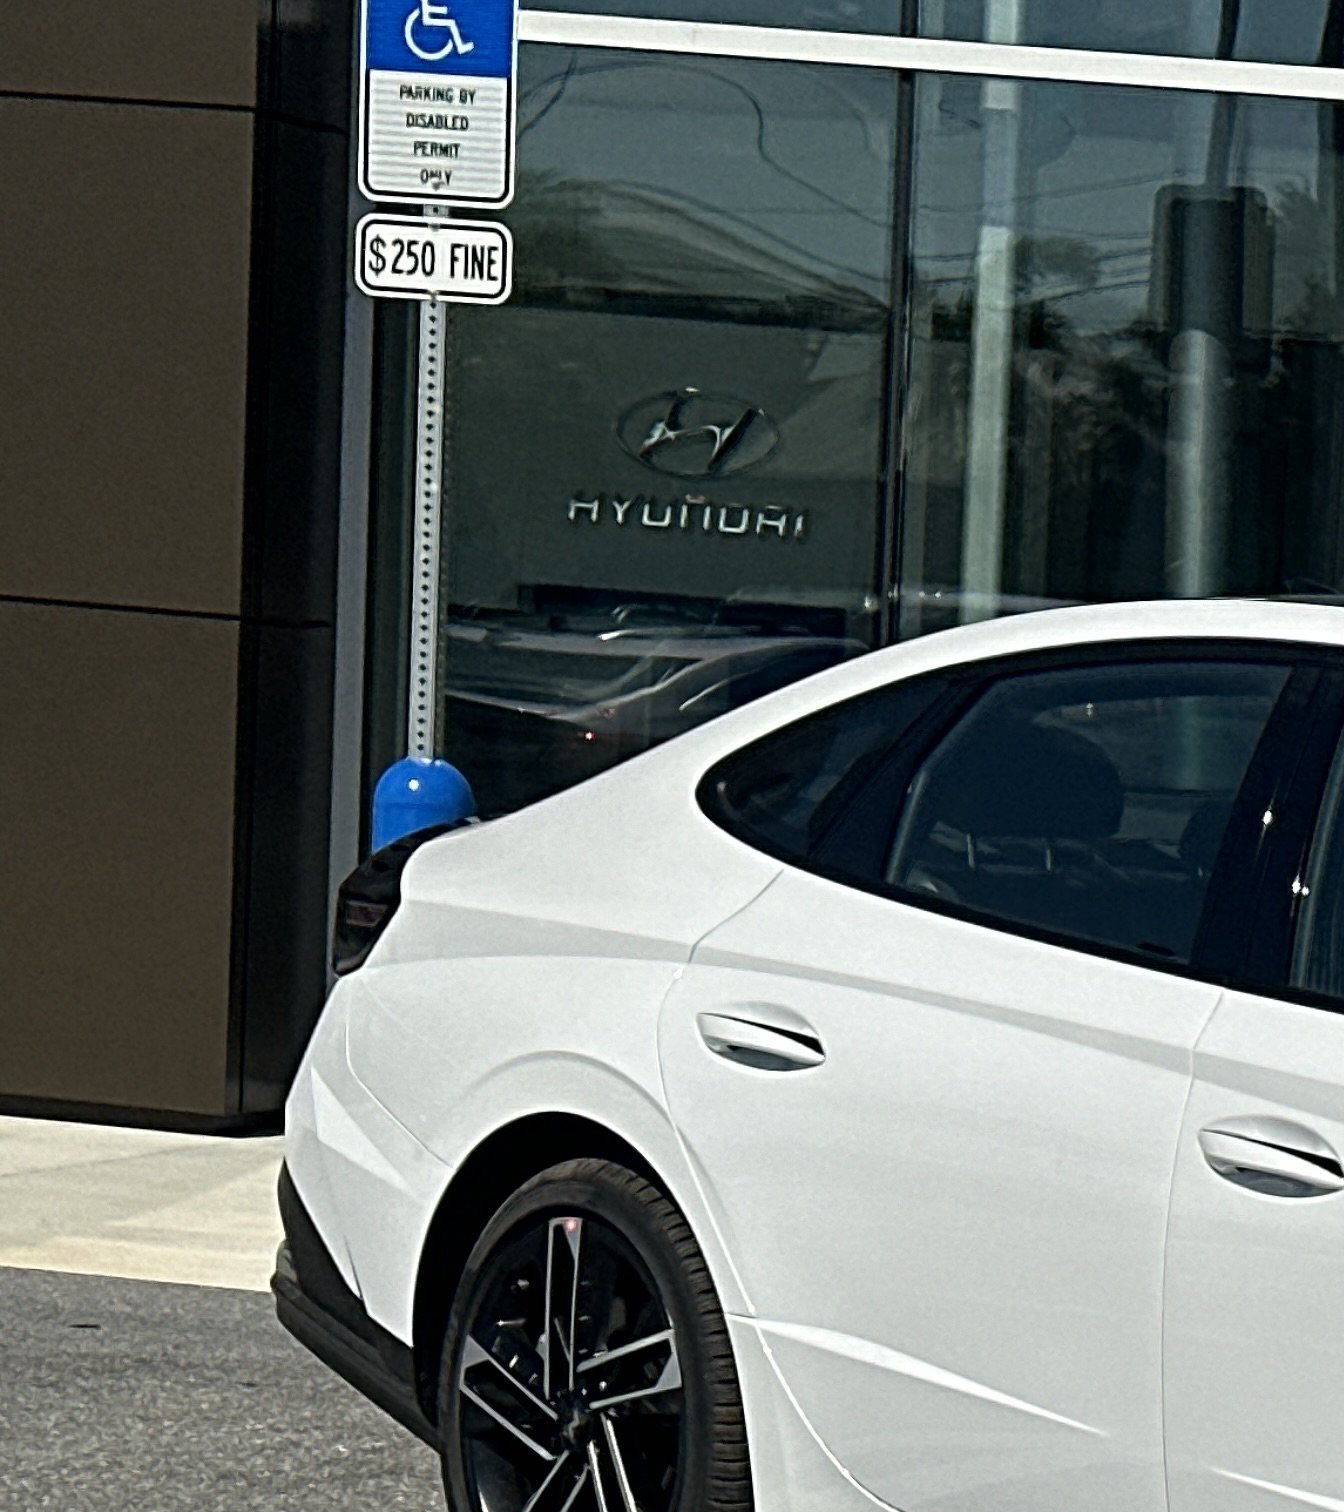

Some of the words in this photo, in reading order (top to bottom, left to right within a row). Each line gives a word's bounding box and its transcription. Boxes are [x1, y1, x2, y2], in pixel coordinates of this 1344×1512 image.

[399, 84, 454, 102] PARKING
[459, 90, 477, 104] BY
[405, 112, 470, 131] DISABLED
[413, 141, 461, 159] PERMIT
[368, 233, 436, 277] $250
[450, 243, 500, 282] FINE
